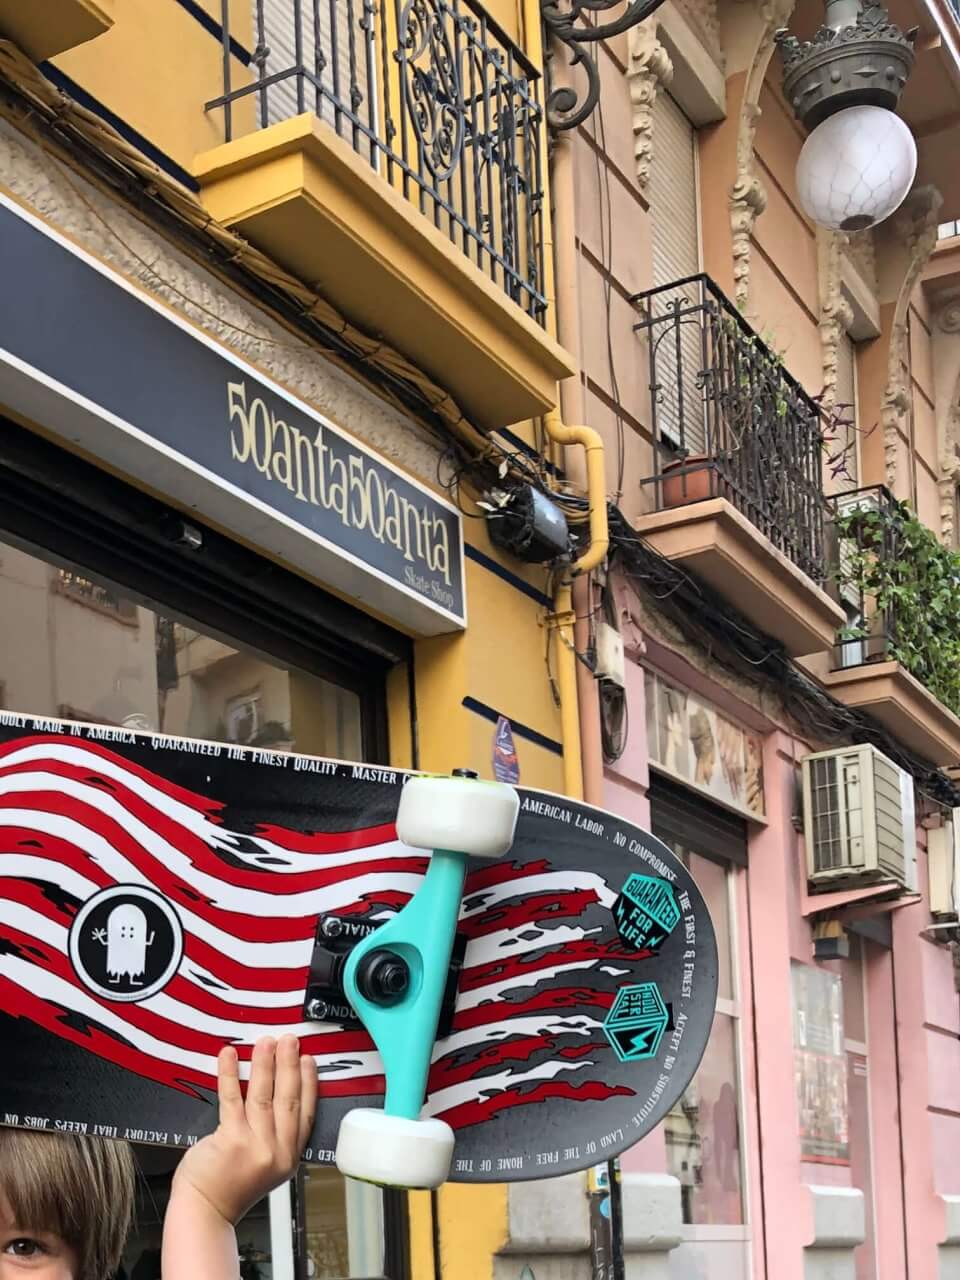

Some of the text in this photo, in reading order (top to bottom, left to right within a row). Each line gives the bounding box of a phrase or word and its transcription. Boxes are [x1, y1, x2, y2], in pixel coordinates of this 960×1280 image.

[405, 565, 454, 611] Skate Shop
[32, 719, 64, 734] MADE
[69, 725, 82, 737] IN
[86, 728, 136, 745] AMERICA
[151, 735, 339, 776] GUARANTEED THE FINEST QUALITY
[352, 766, 399, 785] MASTER
[521, 797, 605, 836] AMERICAN LABOR
[613, 831, 679, 882] NO COMPROMISE
[626, 877, 678, 928] GUARANTEED
[678, 890, 691, 912] THE
[629, 908, 653, 933] FOR
[684, 914, 696, 945] FIRST
[619, 920, 646, 949] LIFE
[681, 963, 696, 999] FINEST
[631, 1012, 688, 1129] ACCEPT NO SUBSTITUTE
[4, 1112, 20, 1125] ON
[23, 1116, 49, 1130] JOBS
[54, 1120, 88, 1135] KEEPS
[93, 1125, 118, 1138] THAT
[124, 1129, 167, 1145] FACTORY
[173, 1133, 182, 1145] A
[536, 1128, 623, 1165] LAND OF THE FREE
[455, 1156, 523, 1172] HOME OF THE
